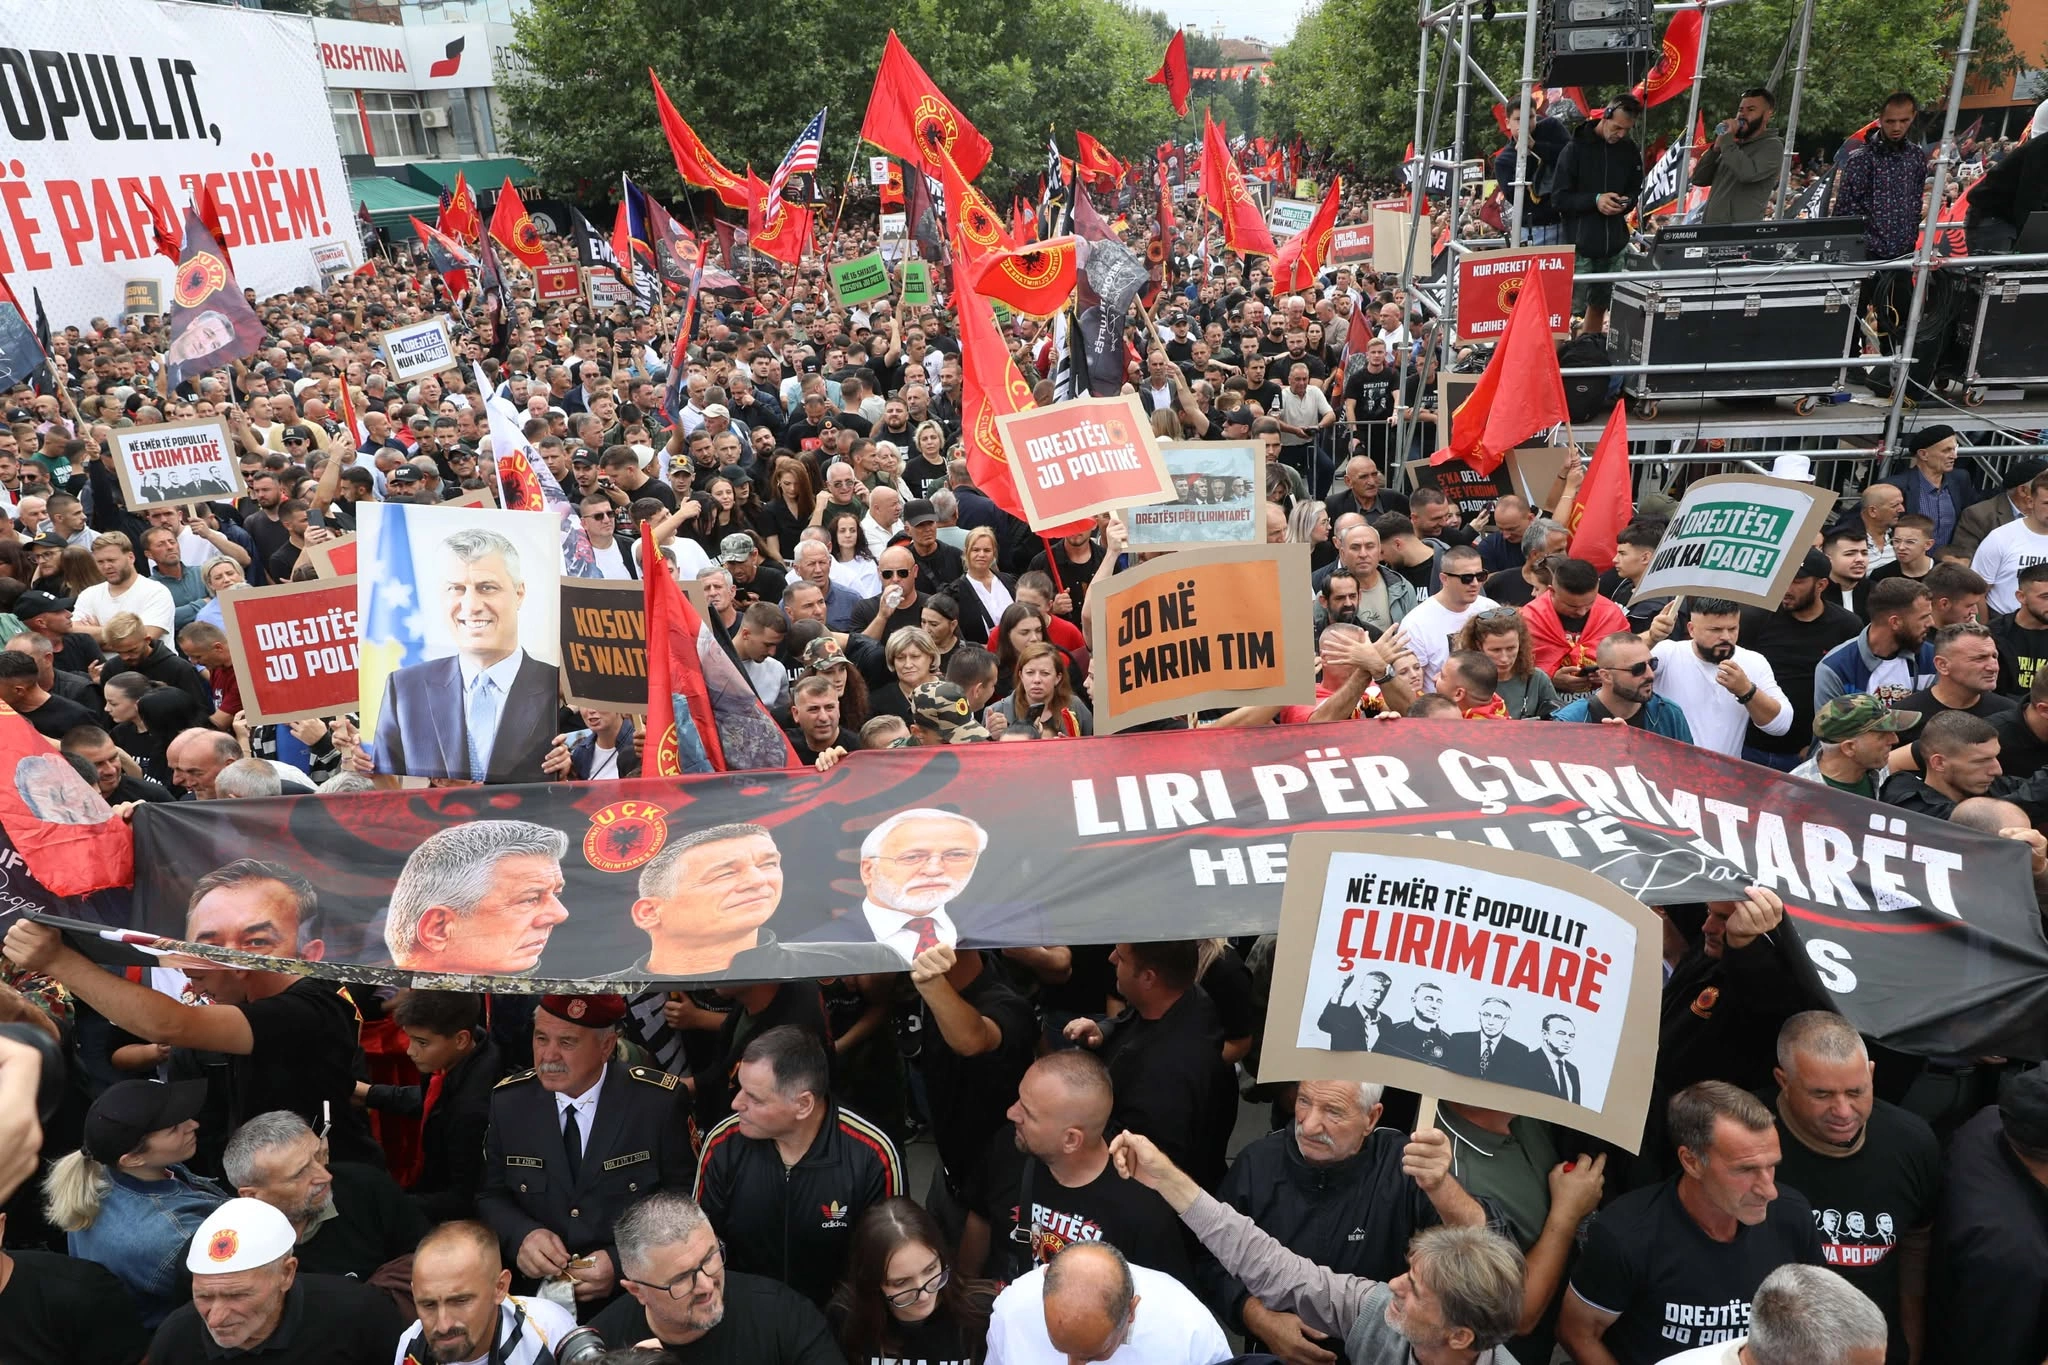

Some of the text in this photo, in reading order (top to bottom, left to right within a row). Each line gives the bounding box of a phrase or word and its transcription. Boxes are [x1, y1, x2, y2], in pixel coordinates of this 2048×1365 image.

[316, 42, 407, 73] RISHTINA
[1671, 231, 1698, 240] YAMAHA
[201, 256, 221, 285] UÇK
[1473, 264, 1491, 277] KUR
[1493, 260, 1527, 275] PREKET
[391, 343, 403, 354] PA
[397, 357, 414, 369] NUK
[415, 353, 427, 366] KA
[129, 433, 207, 452] NË EMËR TË POPULLIT
[1025, 420, 1110, 463] DREJTËSI
[132, 439, 222, 475] ÇLIRIMTARË
[1037, 443, 1141, 489] JO POLITIKË
[515, 454, 542, 508] UÇK
[1463, 485, 1499, 497] VENDIMI
[1136, 509, 1252, 525] DREJTËSI PËR ÇLIRIMTARËT
[1664, 505, 1779, 542] PA DREJTËSI,
[1678, 543, 1706, 567] KA
[1704, 543, 1774, 575] PAQE!
[1118, 579, 1198, 647] JO NË
[265, 653, 298, 682] JO
[569, 642, 591, 672] IS
[1119, 631, 1276, 694] EMRIN TIM
[1071, 769, 1236, 837] LIRI
[1252, 747, 1427, 821] PËR
[597, 803, 660, 825] UÇK
[1346, 873, 1588, 949] NË EMËR TË POPULLIT
[1336, 908, 1612, 1013] ÇLIRIMTARË
[821, 1220, 848, 1228] adidas
[1842, 1247, 1861, 1263] PO
[1662, 1325, 1691, 1344] JO
